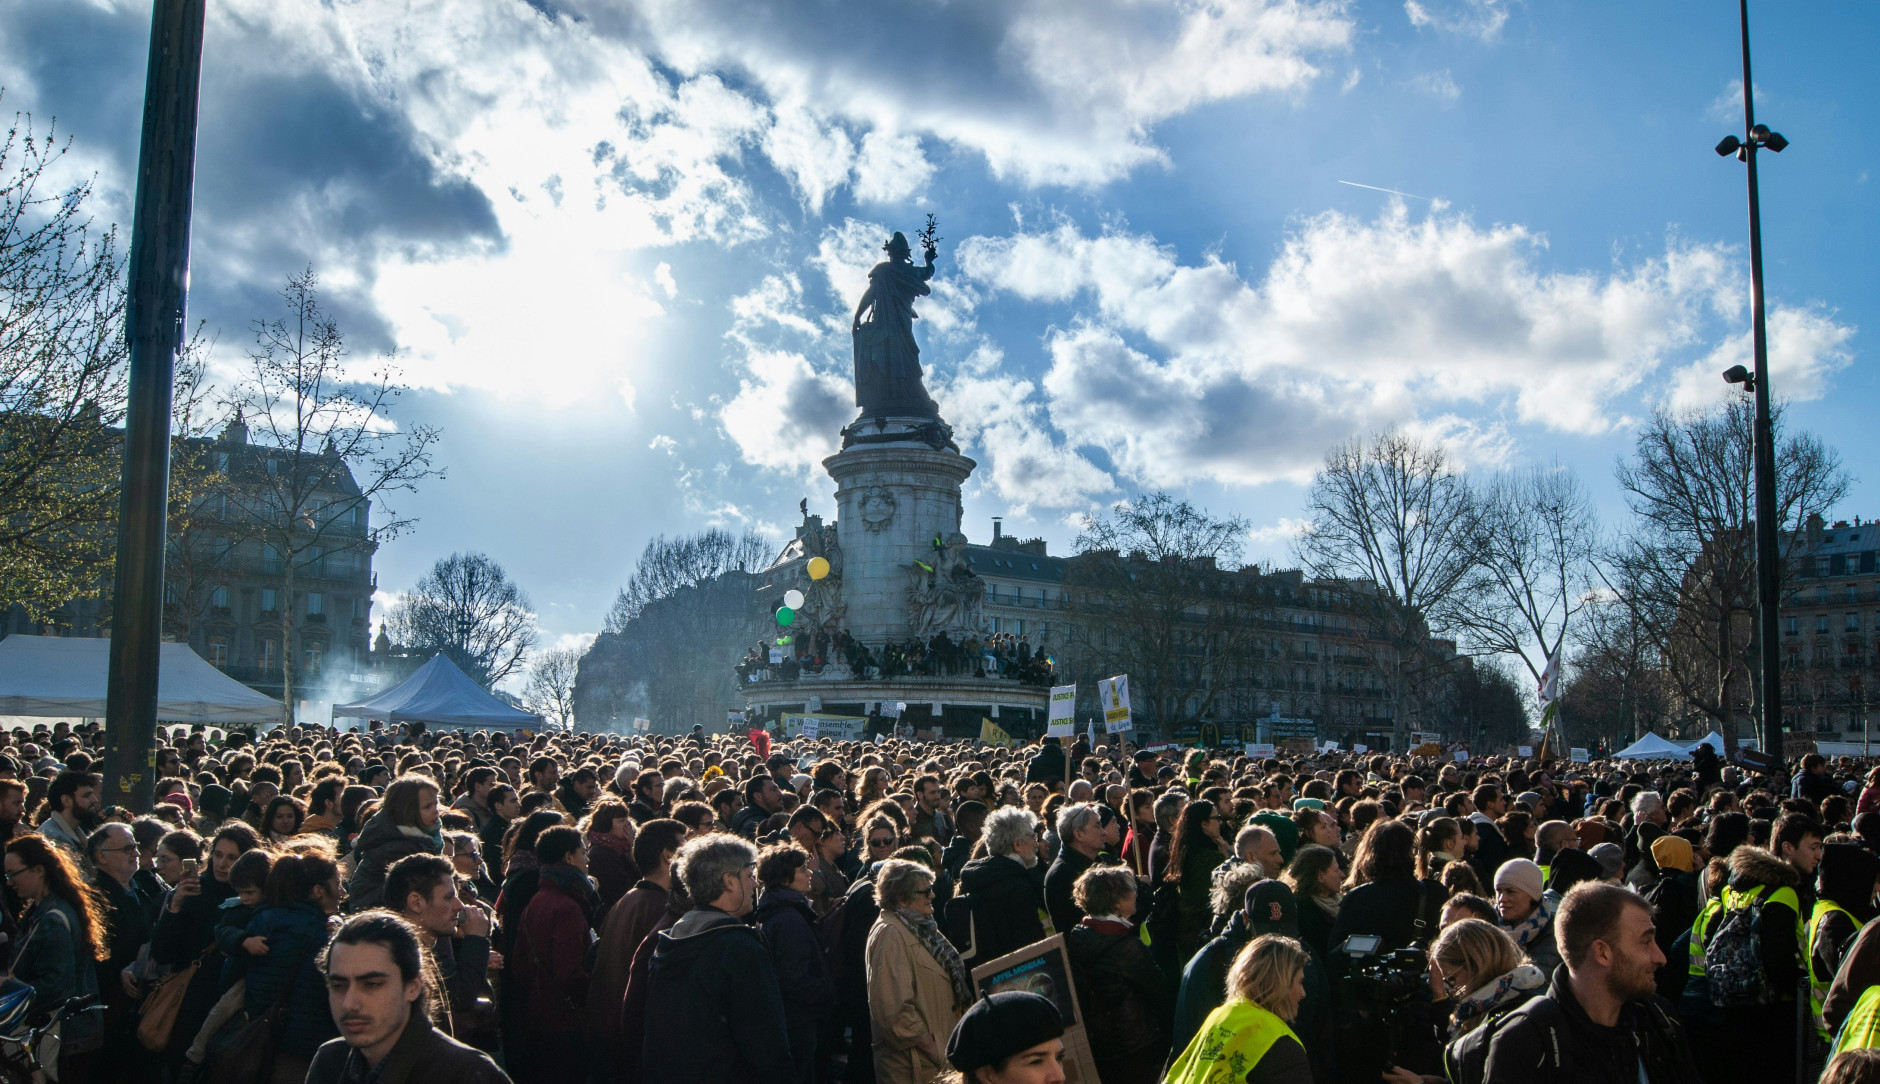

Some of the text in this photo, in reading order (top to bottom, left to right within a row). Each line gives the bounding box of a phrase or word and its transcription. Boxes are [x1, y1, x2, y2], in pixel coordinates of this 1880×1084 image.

[1053, 692, 1069, 701] JUSTICE
[1051, 717, 1068, 726] JUSTICE
[1269, 902, 1282, 920] B
[992, 970, 1012, 984] APPEL
[1013, 957, 1046, 974] MONDIAL
